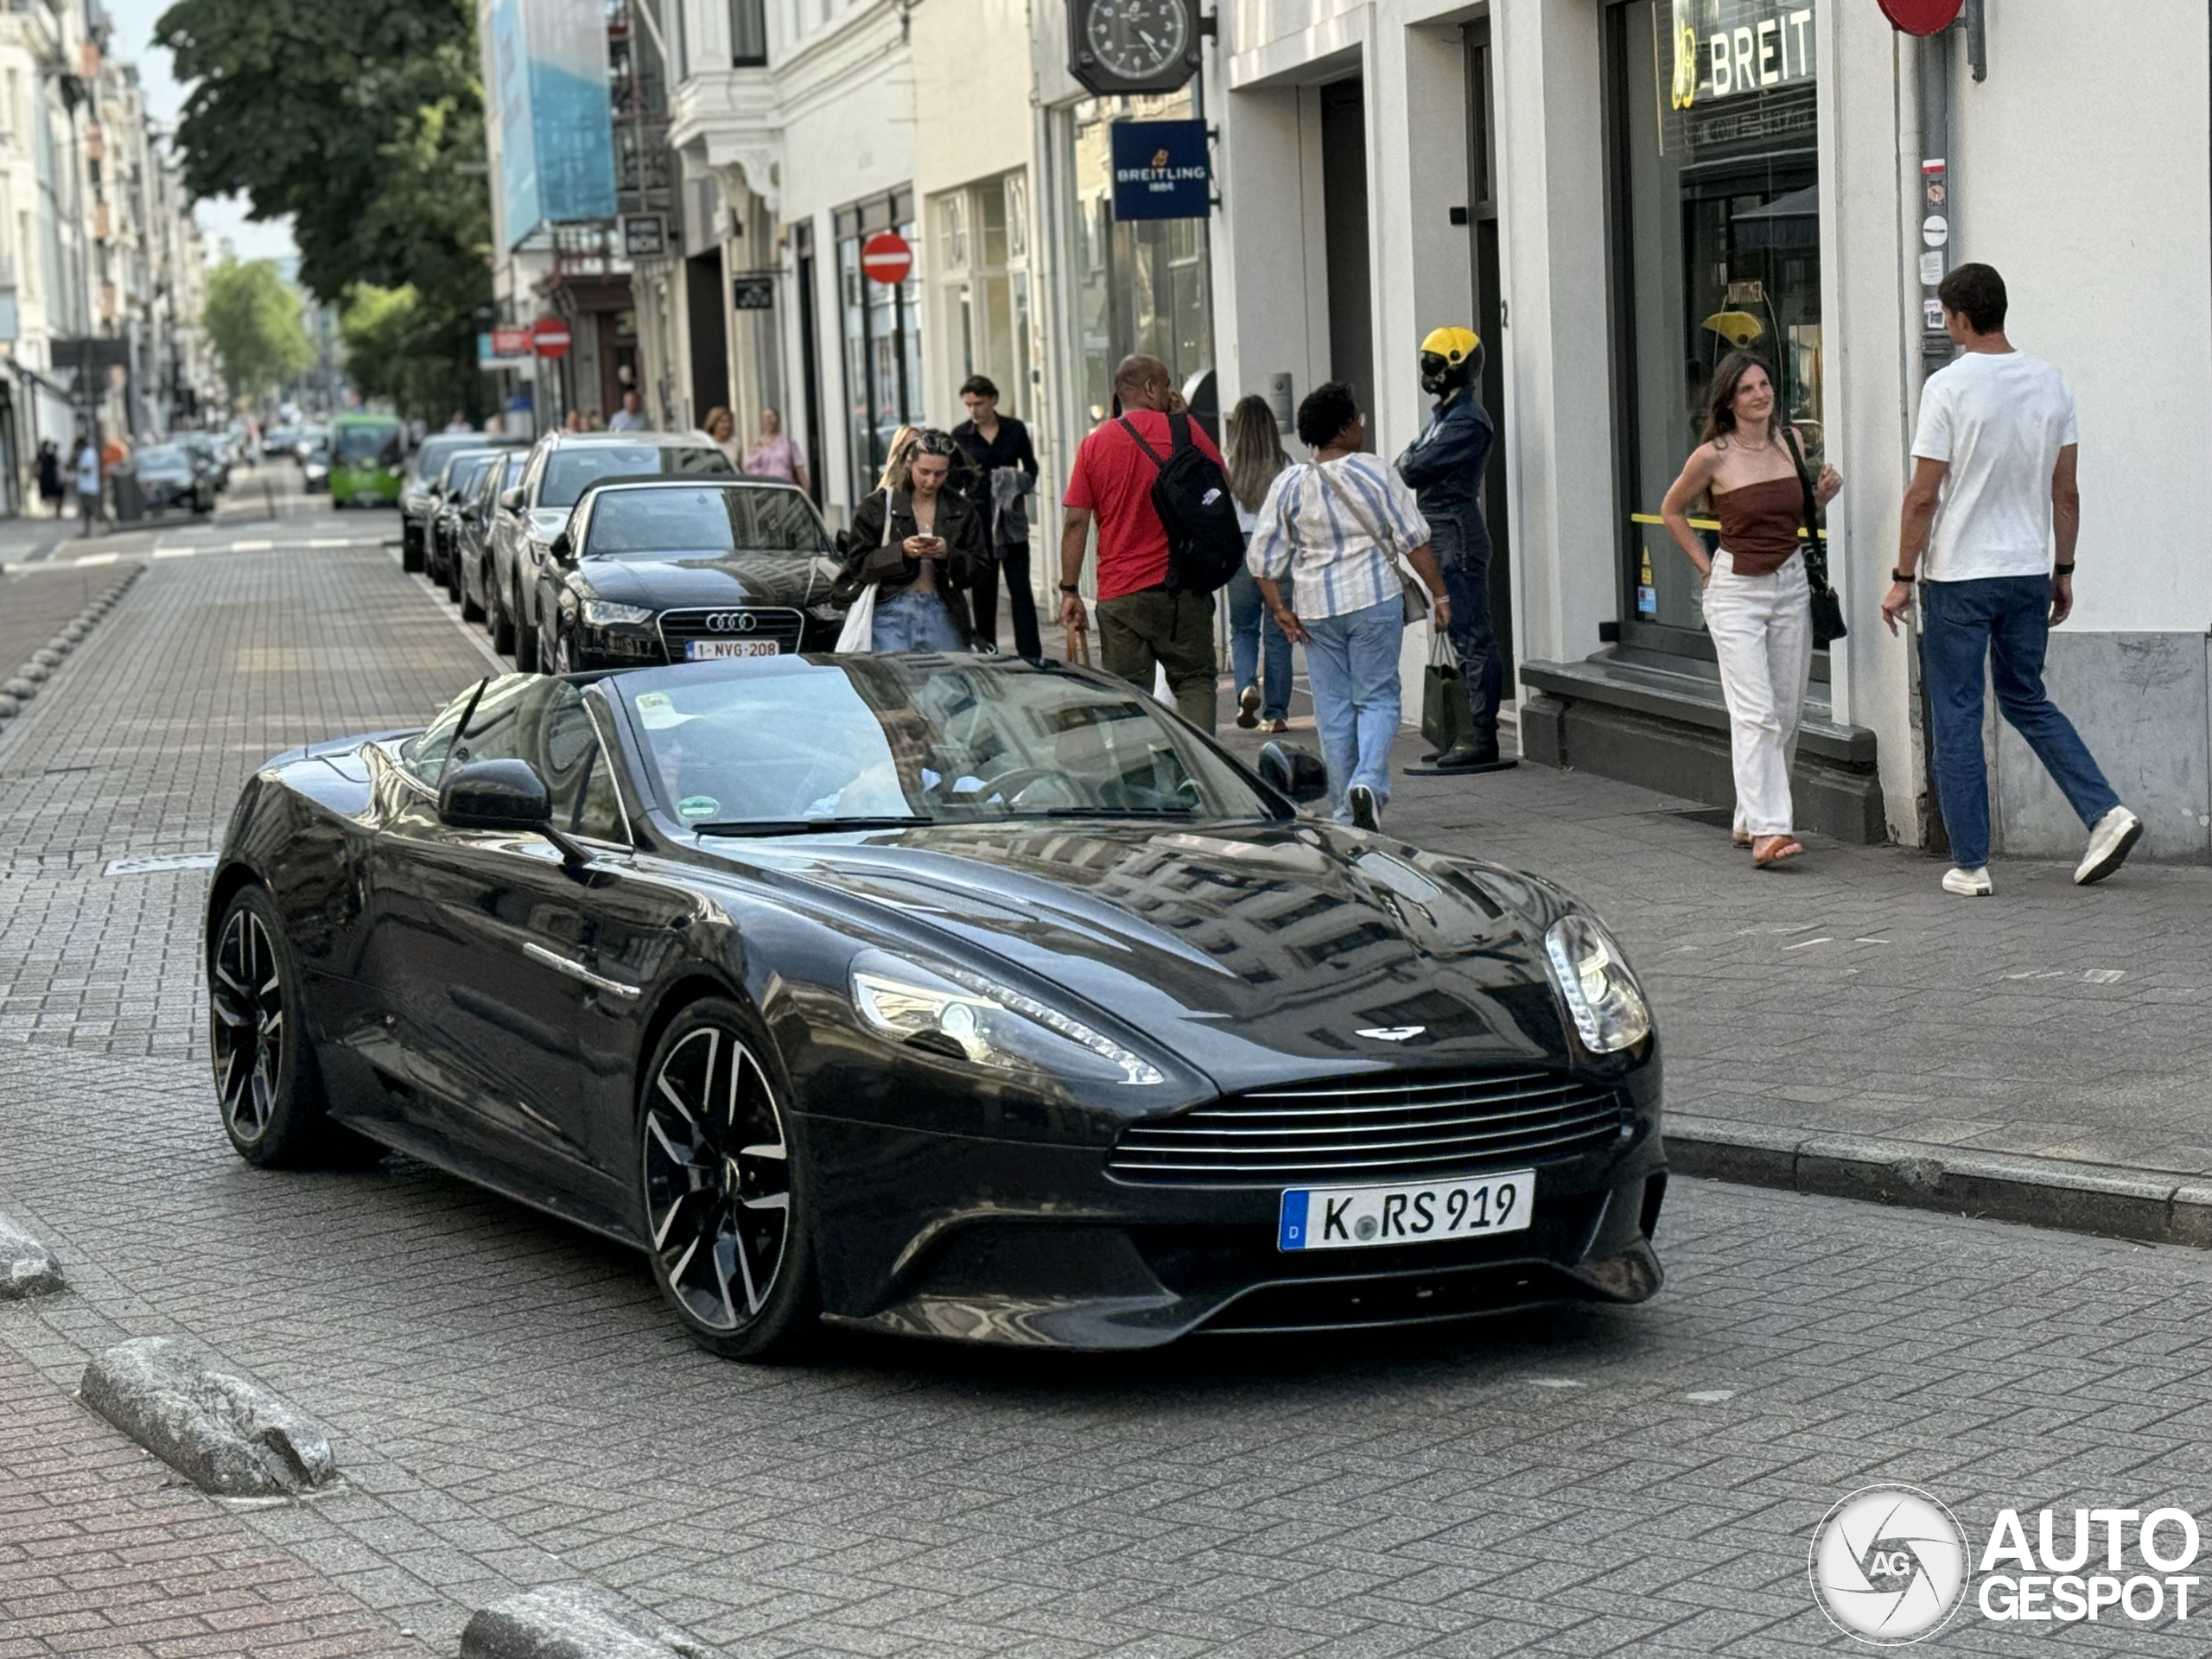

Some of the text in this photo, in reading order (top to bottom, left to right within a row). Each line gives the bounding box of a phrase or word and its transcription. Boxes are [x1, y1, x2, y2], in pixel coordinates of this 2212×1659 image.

[1117, 166, 1206, 182] BREITLING
[1149, 181, 1174, 192] 1884
[627, 234, 661, 253] BOX
[1323, 1197, 1354, 1240] K
[1288, 1225, 1300, 1239] D
